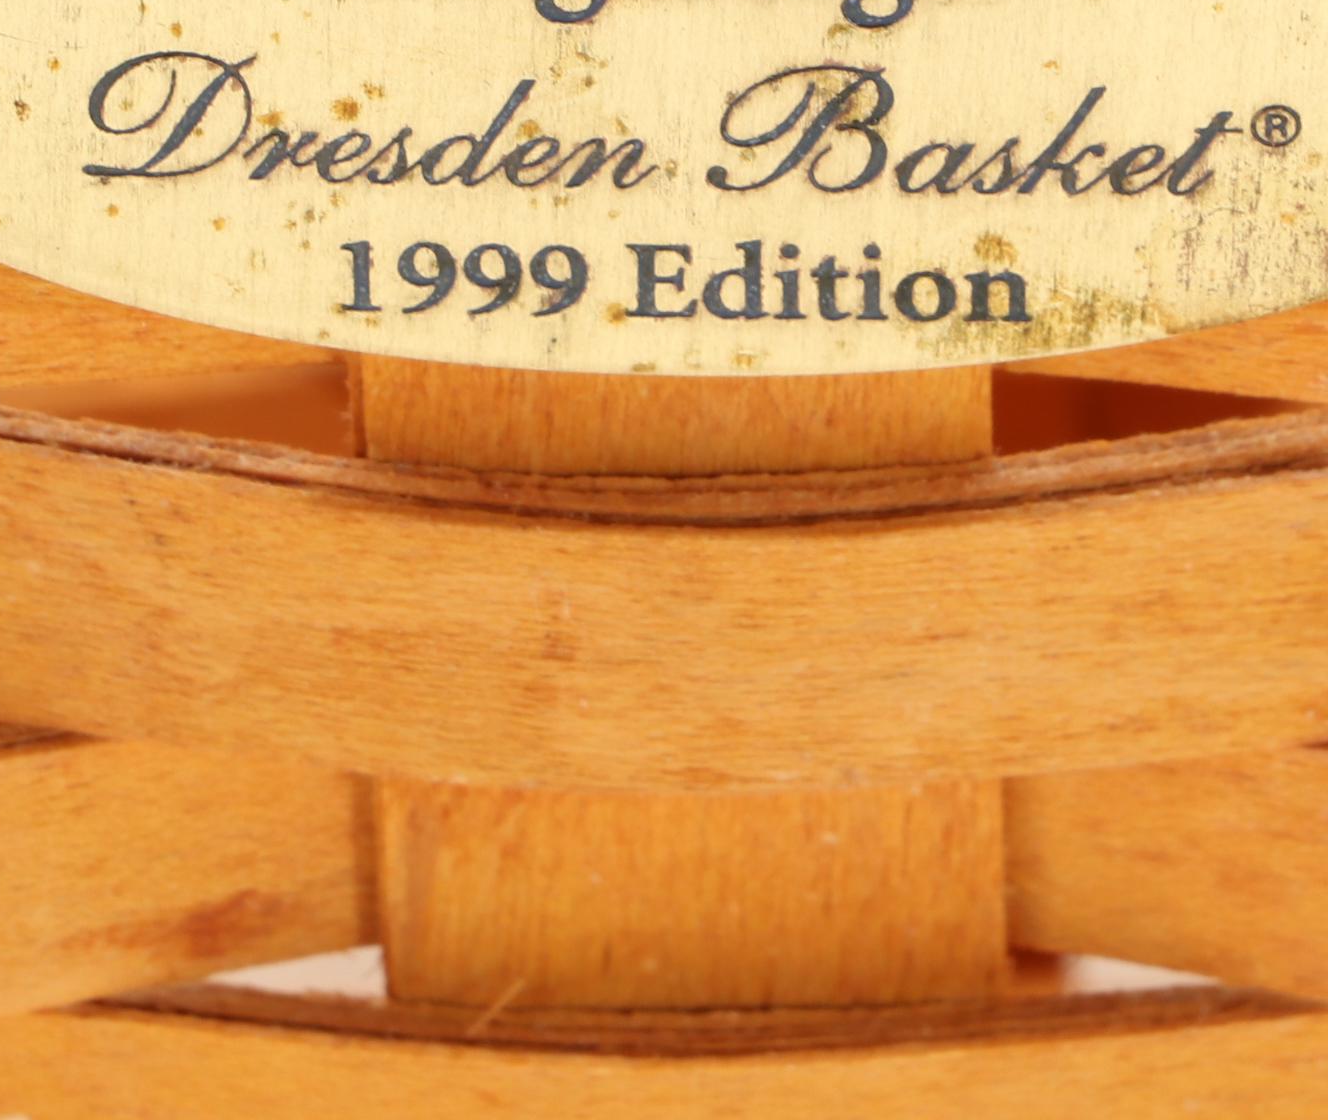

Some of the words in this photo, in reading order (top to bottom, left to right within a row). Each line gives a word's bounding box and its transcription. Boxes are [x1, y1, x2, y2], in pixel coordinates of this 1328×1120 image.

[81, 50, 659, 191] Dresden
[339, 240, 590, 318] 1999
[624, 239, 1033, 323] Edition
